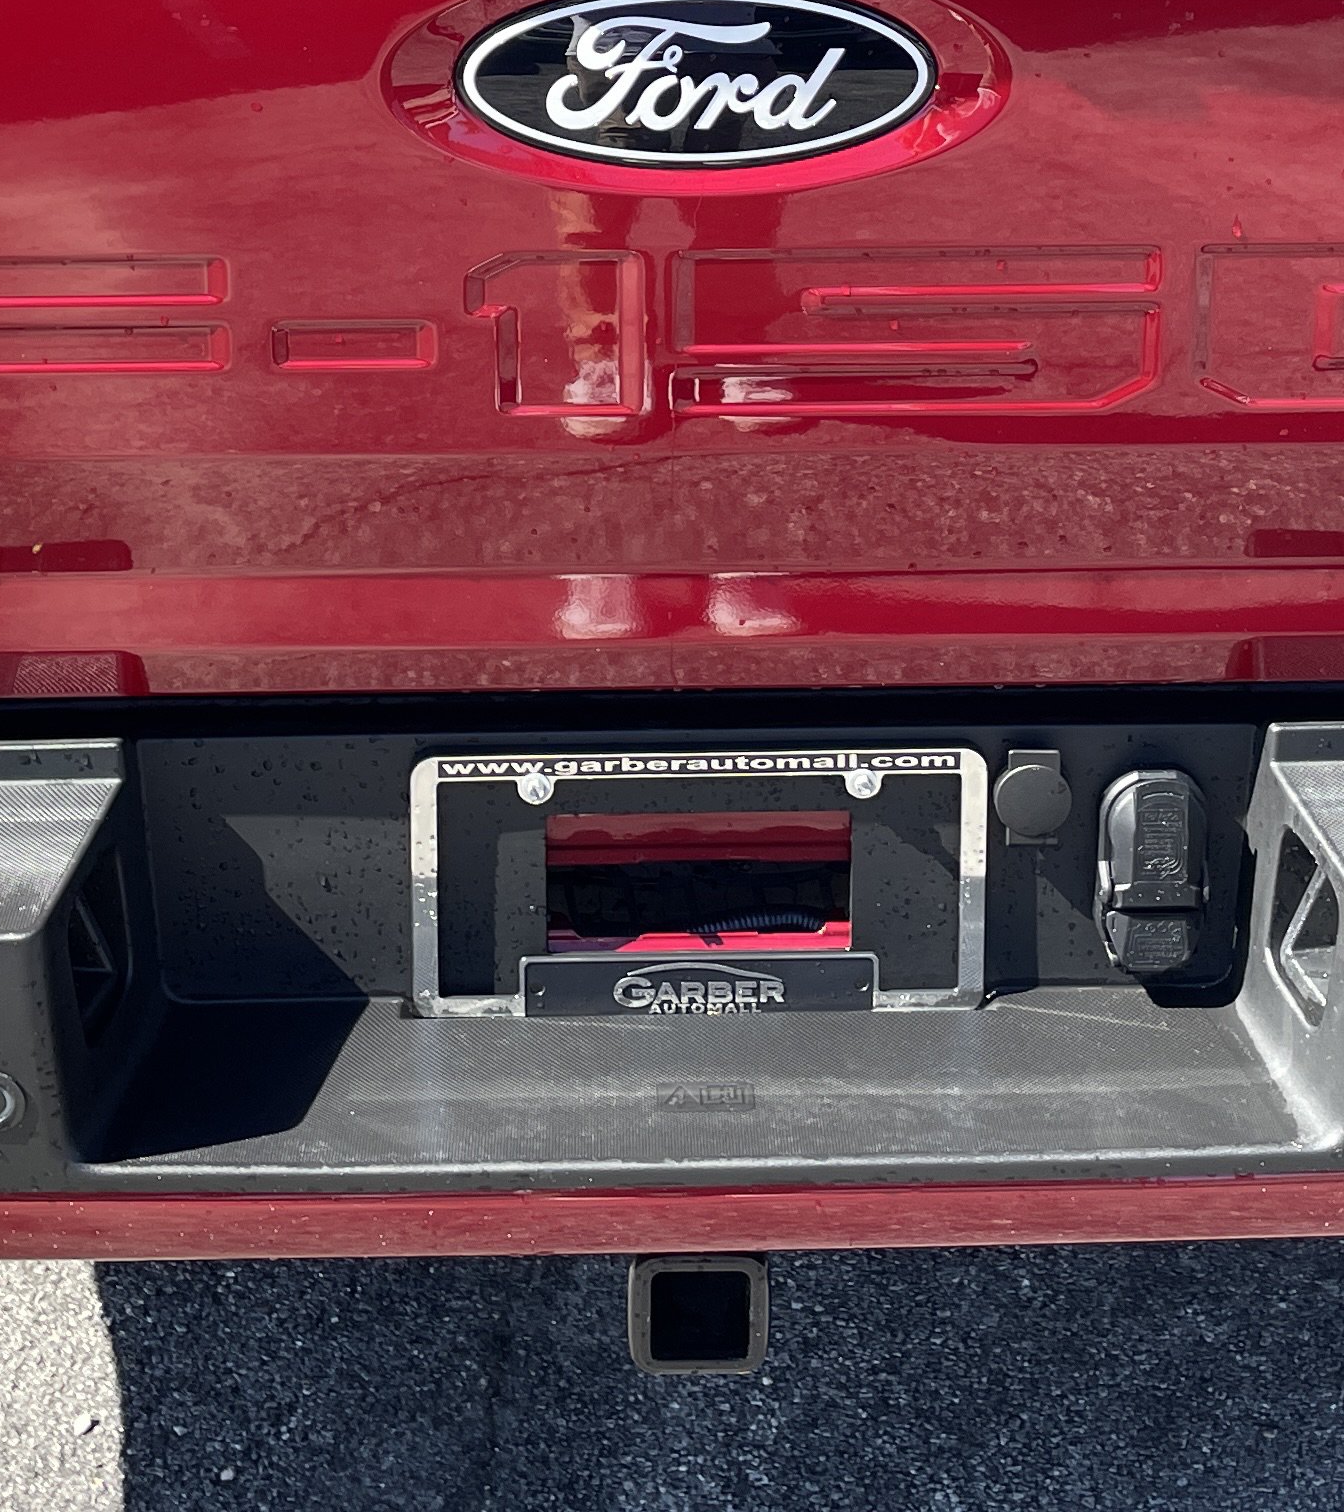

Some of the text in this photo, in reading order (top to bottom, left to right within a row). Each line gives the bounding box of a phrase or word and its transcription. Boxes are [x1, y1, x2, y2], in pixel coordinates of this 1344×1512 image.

[546, 16, 846, 131] Ford
[441, 752, 956, 776] www.garberautomall.com
[613, 975, 786, 1009] GARBER
[647, 1001, 763, 1016] AUTOMALL
